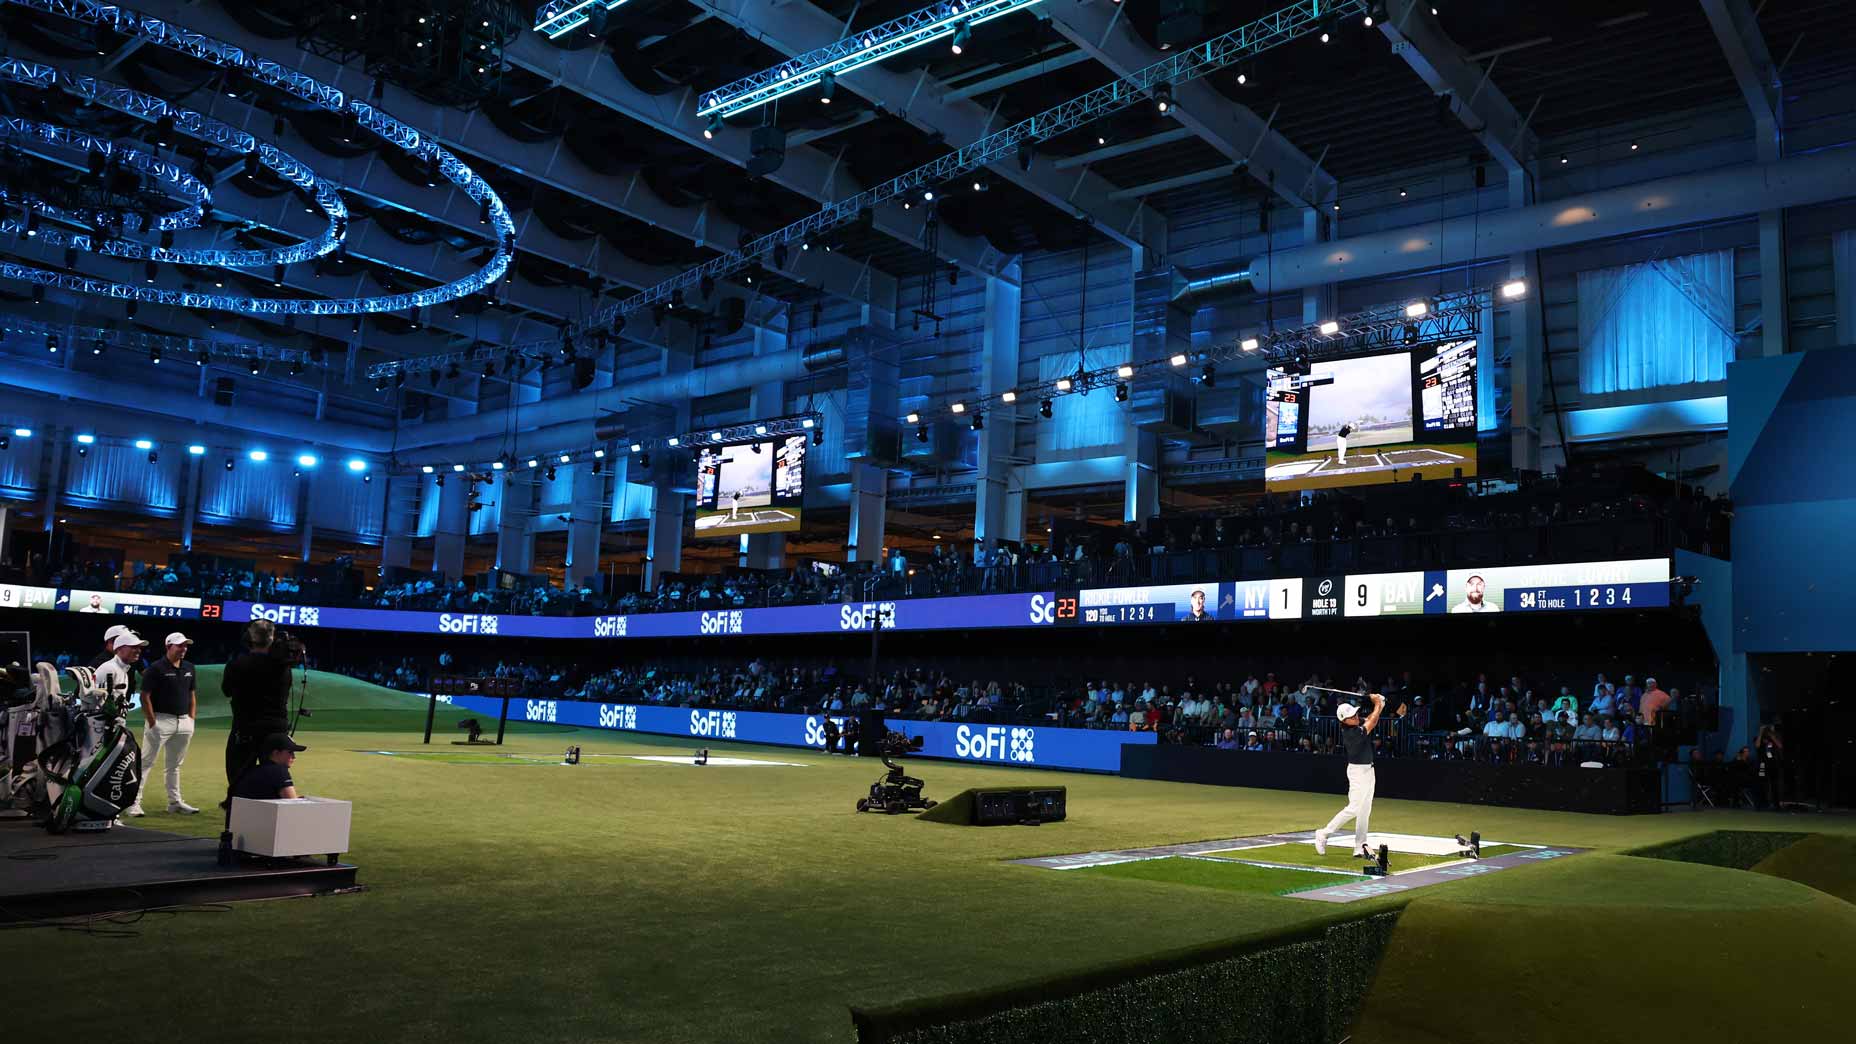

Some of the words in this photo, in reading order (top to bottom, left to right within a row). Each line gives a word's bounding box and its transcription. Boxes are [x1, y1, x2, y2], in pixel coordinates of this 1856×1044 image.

[1425, 377, 1437, 388] 23
[1284, 393, 1296, 403] 23
[4, 590, 11, 601] 9
[24, 591, 49, 604] BAY
[1244, 585, 1266, 608] NY
[1282, 588, 1288, 609] 1
[1357, 584, 1368, 607] 9
[1385, 579, 1417, 604] BAY
[1520, 592, 1535, 608] 34
[1538, 590, 1546, 599] FT
[1574, 589, 1580, 606] 1
[1590, 589, 1599, 605] 2
[1606, 588, 1615, 605] 3
[1622, 587, 1631, 604] 4
[202, 605, 220, 618] 23
[250, 603, 297, 624] SoFi
[1057, 598, 1076, 618] 23
[1120, 608, 1125, 620] 1
[1129, 607, 1135, 620] 2
[1139, 607, 1145, 620] 3
[1148, 606, 1154, 619] 4
[1313, 599, 1329, 608] HOLE
[1538, 600, 1546, 608] TO
[1548, 599, 1565, 608] HOLE
[439, 613, 478, 633] SoFi
[701, 611, 728, 634] SoFi
[840, 603, 877, 630] SoFi
[1085, 609, 1098, 622] 120
[594, 616, 616, 637] SoFi
[526, 699, 546, 721] SoFi
[600, 704, 624, 728] SoFi
[690, 709, 720, 737] SoFi
[956, 725, 1006, 760] SoFi
[110, 751, 136, 801] Callaway
